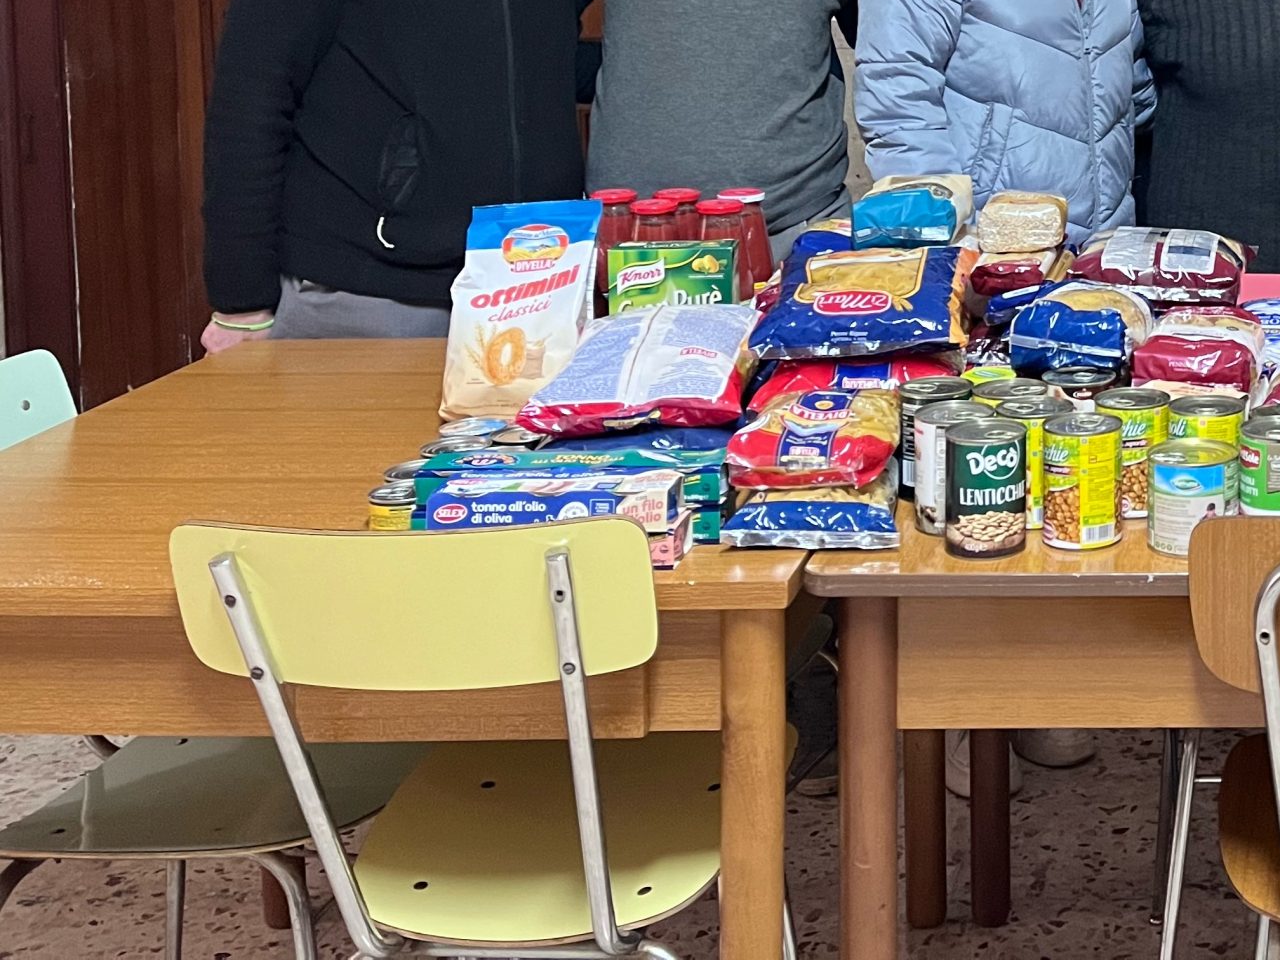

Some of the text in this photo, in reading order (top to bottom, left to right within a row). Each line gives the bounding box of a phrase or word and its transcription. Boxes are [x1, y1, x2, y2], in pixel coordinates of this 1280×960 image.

[516, 260, 552, 272] DIVELLA
[620, 267, 663, 286] Knorr
[672, 284, 723, 305] Purè
[487, 294, 552, 322] classici
[792, 406, 847, 421] DIVELLA
[437, 508, 465, 518] SELEX
[471, 500, 547, 512] tonno all'olio
[622, 504, 639, 515] un
[641, 499, 664, 512] filo
[471, 513, 513, 524] di oliva
[633, 511, 662, 524] 'olio
